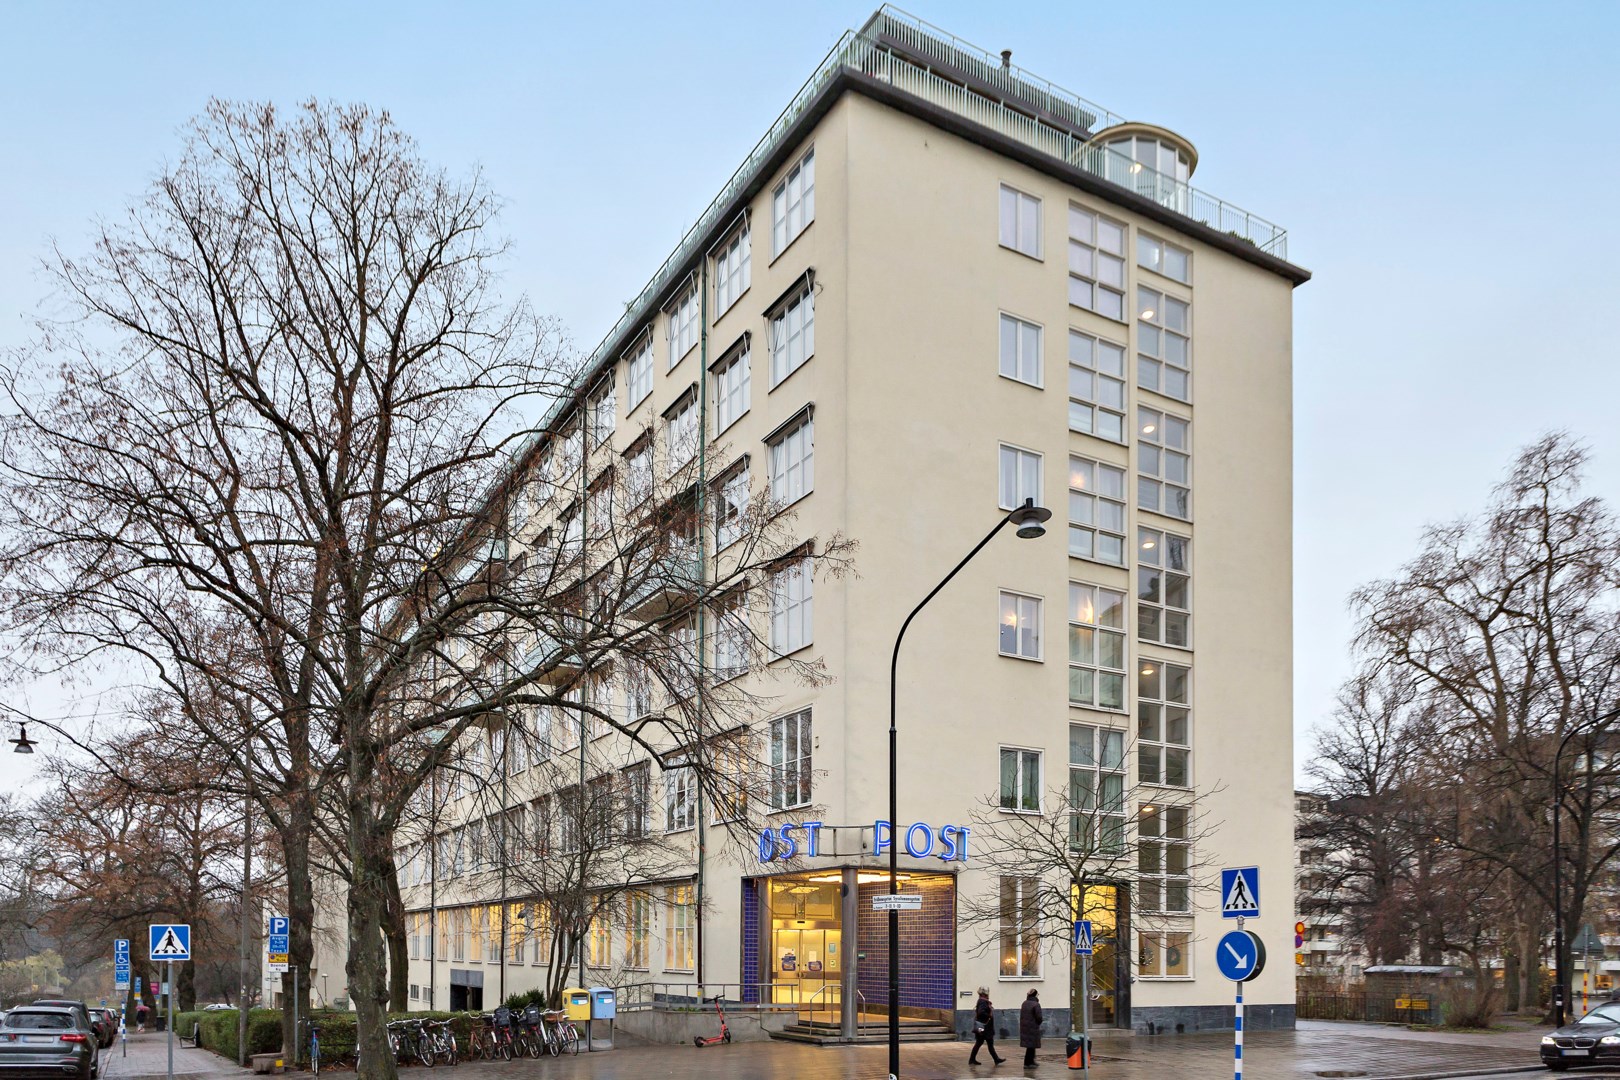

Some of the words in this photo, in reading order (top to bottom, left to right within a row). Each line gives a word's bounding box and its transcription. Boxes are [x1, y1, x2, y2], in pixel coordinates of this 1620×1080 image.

[873, 820, 970, 861] POST
[274, 919, 286, 934] P
[118, 940, 127, 951] P
